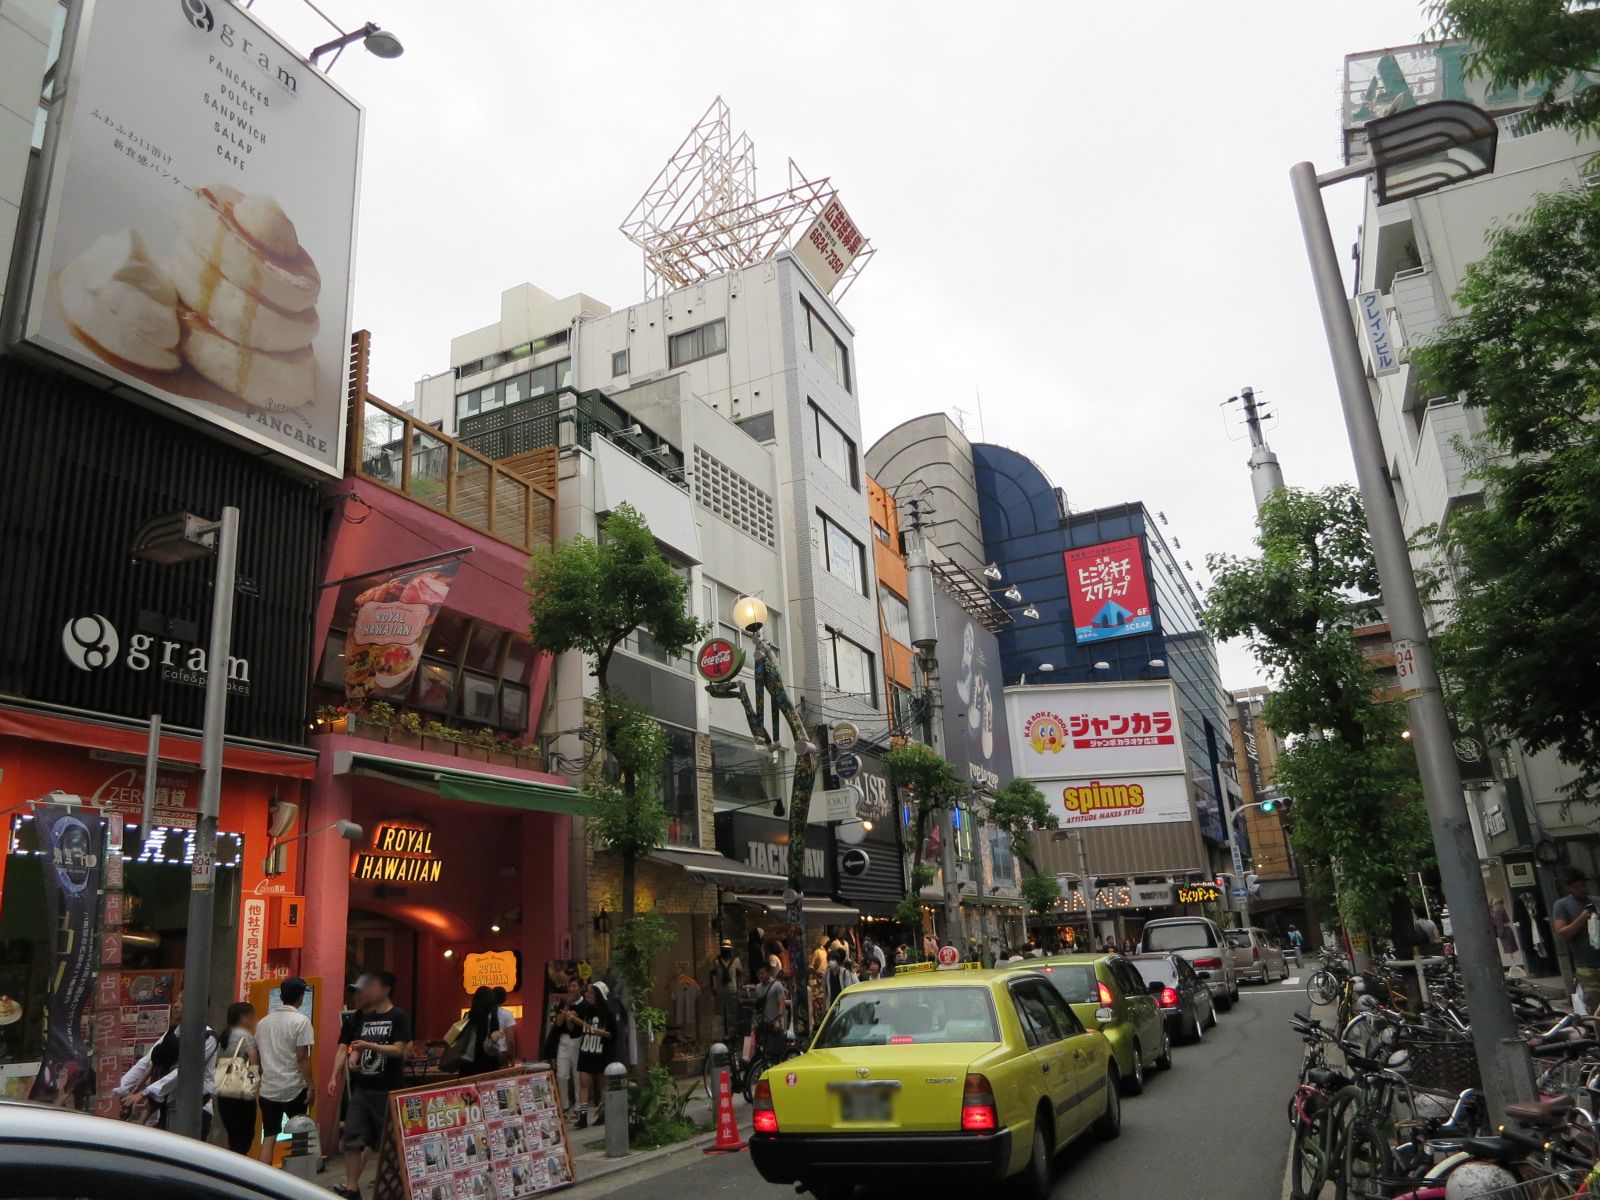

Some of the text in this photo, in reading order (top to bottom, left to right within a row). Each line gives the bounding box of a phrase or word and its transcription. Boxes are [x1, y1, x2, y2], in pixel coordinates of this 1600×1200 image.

[220, 23, 298, 93] gram
[208, 54, 270, 107] PANCAKES
[220, 84, 255, 116] DOLCE
[202, 92, 267, 144] SANDWICH
[213, 121, 253, 154] SALAD
[216, 144, 246, 171] CAFE
[809, 227, 844, 275] 6624-7350
[1363, 294, 1393, 369] クレインビル
[1081, 575, 1131, 602] スクラップ
[375, 612, 406, 623] ROYAL
[1136, 607, 1148, 616] 6F
[362, 624, 412, 637] HAWAIIAN
[1125, 620, 1150, 631] SCRAP
[126, 633, 250, 683] gram
[1069, 711, 1172, 737] ジャンカラ
[109, 786, 147, 803] ZER
[1063, 781, 1145, 815] spinns
[1066, 807, 1145, 824] ATTITUDE MAKES STYLE!
[383, 828, 432, 854] ROYAL
[361, 856, 442, 882] HAWAIIAN
[744, 841, 825, 878] JACKAW
[471, 973, 509, 987] HAWAIIAN
[478, 961, 502, 974] ROYAL
[427, 1095, 448, 1111] 人気
[427, 1106, 481, 1130] BEST 10
